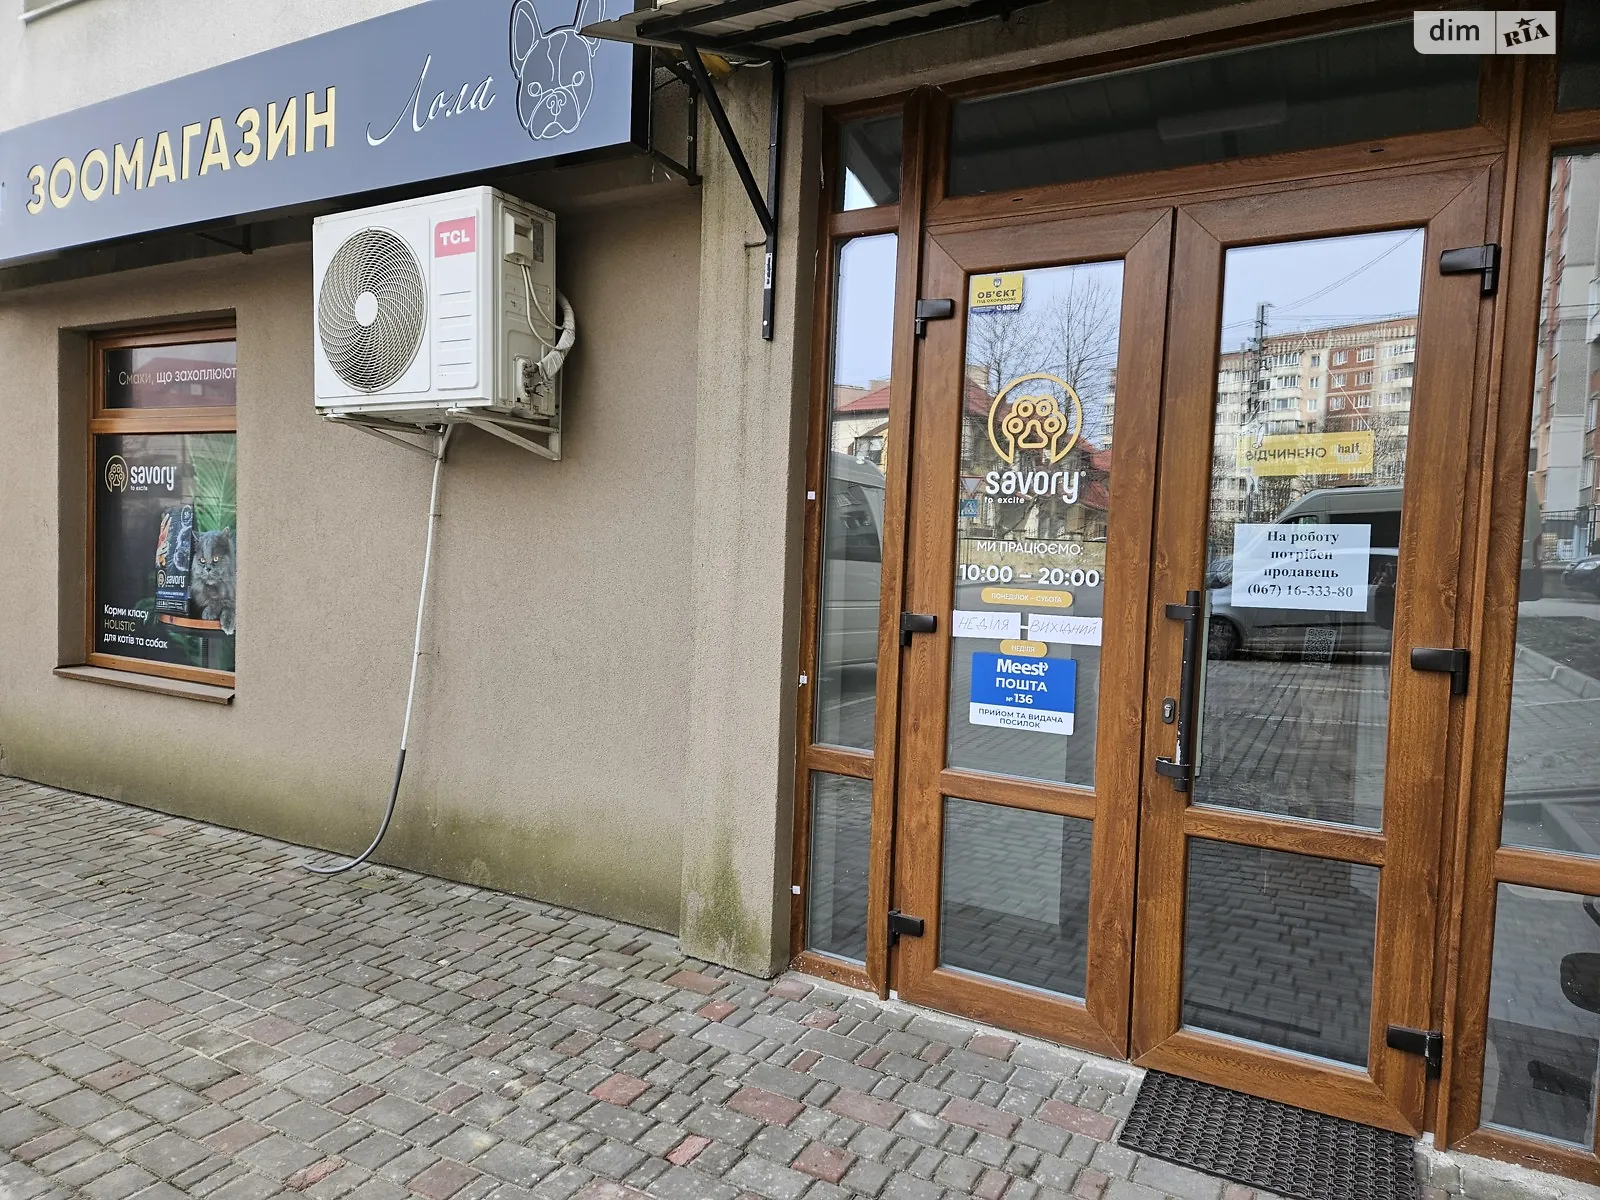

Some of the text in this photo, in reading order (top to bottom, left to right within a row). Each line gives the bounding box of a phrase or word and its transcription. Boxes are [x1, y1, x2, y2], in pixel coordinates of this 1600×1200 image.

[26, 54, 496, 215] ЗООМАГАЗИН Лола
[439, 229, 470, 245] TCL
[156, 371, 173, 384] що
[1245, 447, 1327, 462] ВІДЧИНЕНО
[130, 465, 175, 491] savory
[985, 471, 1080, 504] savory
[984, 496, 1025, 504] to excite
[1267, 531, 1339, 545] На роботу
[977, 541, 1084, 556] МИ ПРАЦЮЄМО:
[1270, 548, 1333, 562] потрібен
[959, 564, 1013, 583] 10:00
[1037, 567, 1100, 587] 20:00
[1263, 568, 1339, 578] продавець
[1247, 584, 1353, 598] (067) 16-333-80
[104, 604, 149, 619] Корми класу
[104, 619, 136, 632] HOLISTIC
[958, 616, 1010, 631] НЕДІЛЯ
[104, 633, 168, 649] для котів та собак
[1011, 645, 1035, 653] НЕДІЛЯ
[996, 658, 1049, 677] Meest
[995, 677, 1048, 692] ПОШТА
[978, 708, 1014, 718] ПРИЙОМ
[1028, 713, 1064, 723] ВИДАЧА
[999, 717, 1041, 728] ПОСИЛОК
